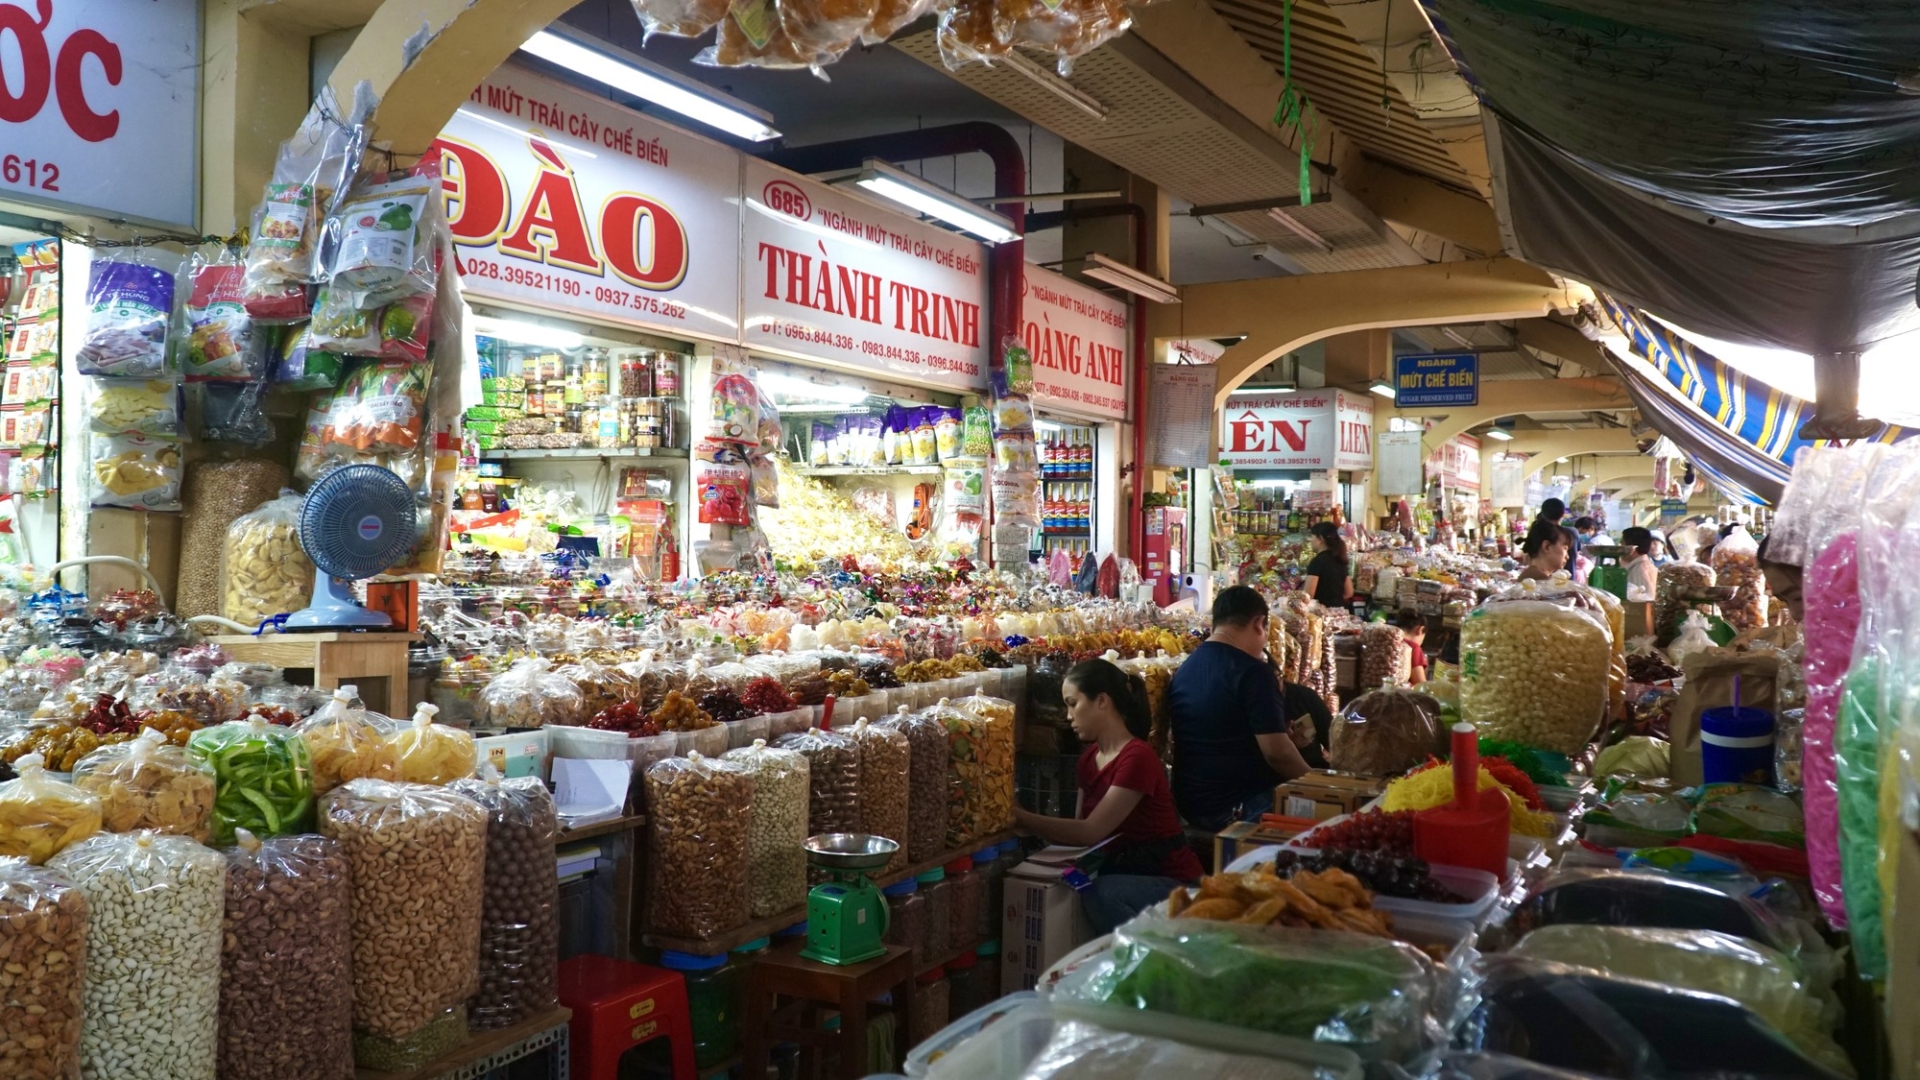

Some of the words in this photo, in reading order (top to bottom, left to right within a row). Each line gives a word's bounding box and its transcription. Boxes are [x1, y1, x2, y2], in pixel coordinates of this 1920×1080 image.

[488, 85, 524, 116] MỨT
[528, 99, 564, 130] TRÁI
[569, 113, 599, 143] CÂY
[603, 127, 633, 155] CHẾ
[637, 138, 668, 167] BIẾN
[3, 154, 60, 192] 612
[424, 128, 689, 291] ĐÀO
[771, 186, 804, 218] 685
[866, 223, 887, 247] MỨT
[890, 233, 912, 253] TRÁI
[914, 240, 934, 260] CÂY
[935, 247, 954, 268] CHẾ
[468, 258, 581, 297] 028.39521190
[594, 286, 686, 320] 0937.575.262
[759, 239, 883, 325] THÀNH
[890, 281, 980, 349] TRINH
[862, 339, 920, 365] 0983.844.336
[1085, 341, 1123, 387] ANH
[1417, 358, 1456, 367] NGÀNH
[1400, 371, 1423, 388] MỨT
[1425, 368, 1446, 388] CHẾ
[1448, 368, 1473, 387] BIẾN
[1420, 394, 1454, 402] PRESERVED
[1455, 393, 1472, 401] FRUIT
[1243, 398, 1262, 409] TRÁI
[1263, 398, 1281, 409] CÂY
[1283, 396, 1301, 408] CHẾ
[1218, 409, 1312, 452] ÊN
[1340, 413, 1371, 455] LIÊN
